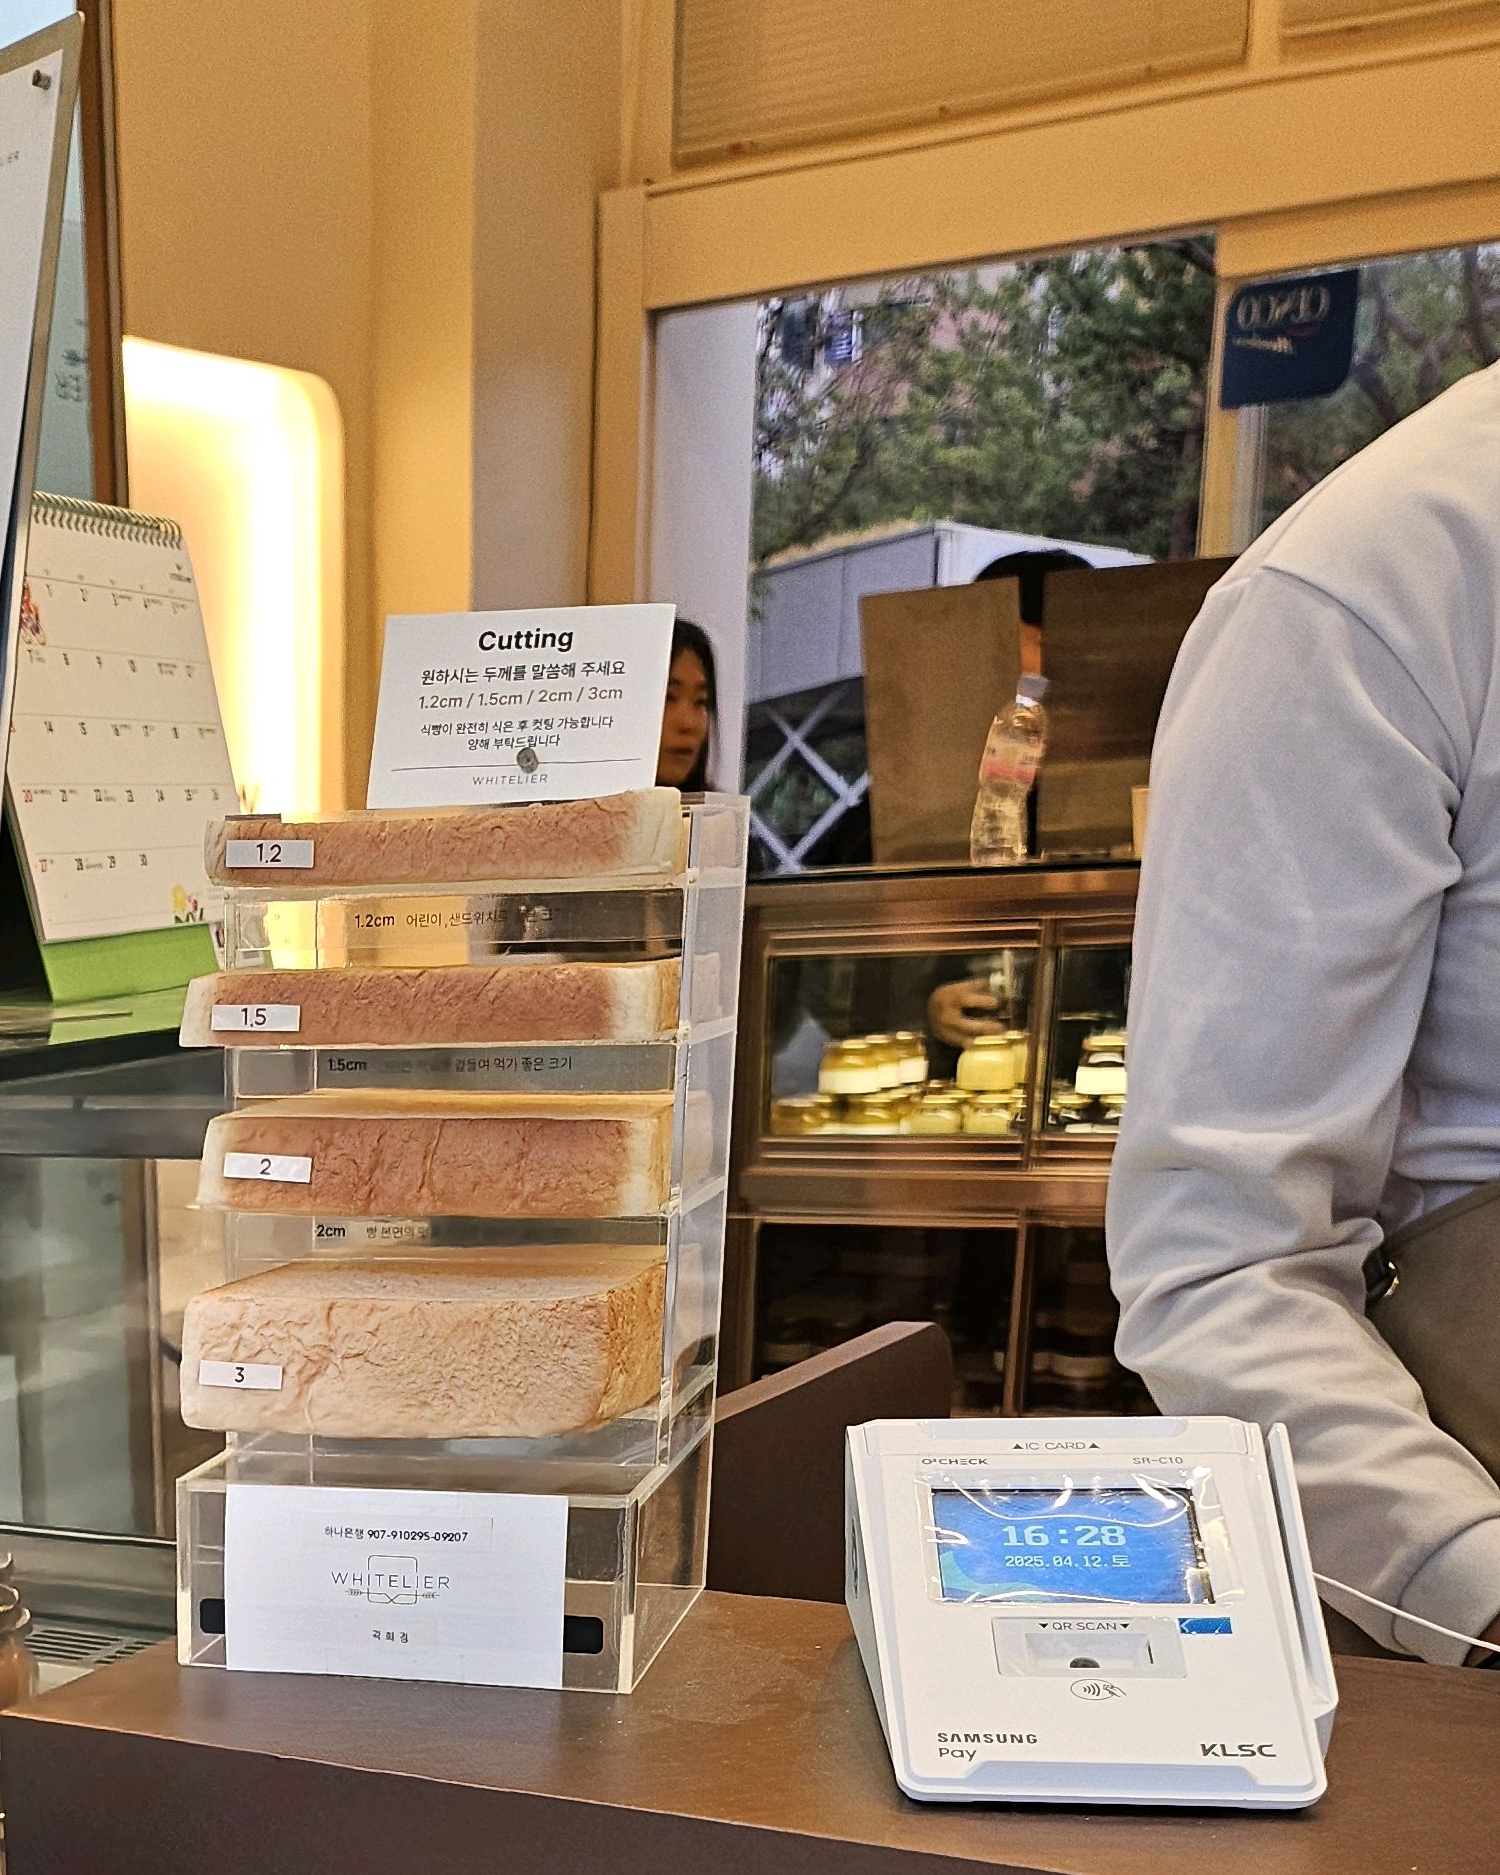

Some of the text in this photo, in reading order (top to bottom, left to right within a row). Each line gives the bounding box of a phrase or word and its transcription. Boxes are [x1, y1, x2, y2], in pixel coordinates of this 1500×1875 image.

[478, 626, 574, 654] Cutting
[420, 658, 626, 686] 원하시는 두께를 말씀해 주세요
[418, 694, 464, 710] 1.2cm
[478, 692, 524, 708] 1.5cm
[538, 688, 574, 706] 2cm
[588, 686, 624, 702] 3cm
[420, 722, 454, 738] 식빵이
[456, 720, 490, 736] 완전히
[492, 720, 514, 734] 식은
[556, 714, 614, 730] 가능합니다
[468, 736, 490, 752] 양해
[472, 772, 548, 786] WHITELIER
[254, 842, 284, 866] 1.2
[354, 914, 396, 930] 1.2cm
[240, 1006, 268, 1028] 1.5
[548, 1056, 572, 1072] 크기
[258, 1158, 272, 1176] 2
[316, 1224, 346, 1238] 2cm
[232, 1366, 246, 1384] 3
[1024, 1442, 1086, 1450] IC CARD
[1132, 1456, 1184, 1466] SR-C10
[324, 1526, 470, 1544] 하나은행 907-910295-09207
[1002, 1524, 1128, 1548] 16:28
[330, 1570, 452, 1590] WHITELIER
[1052, 1620, 1118, 1632] QR SCAN
[936, 1732, 1038, 1746] SAMSUNG
[938, 1746, 978, 1762] Pay
[1198, 1742, 1278, 1758] KLSC
